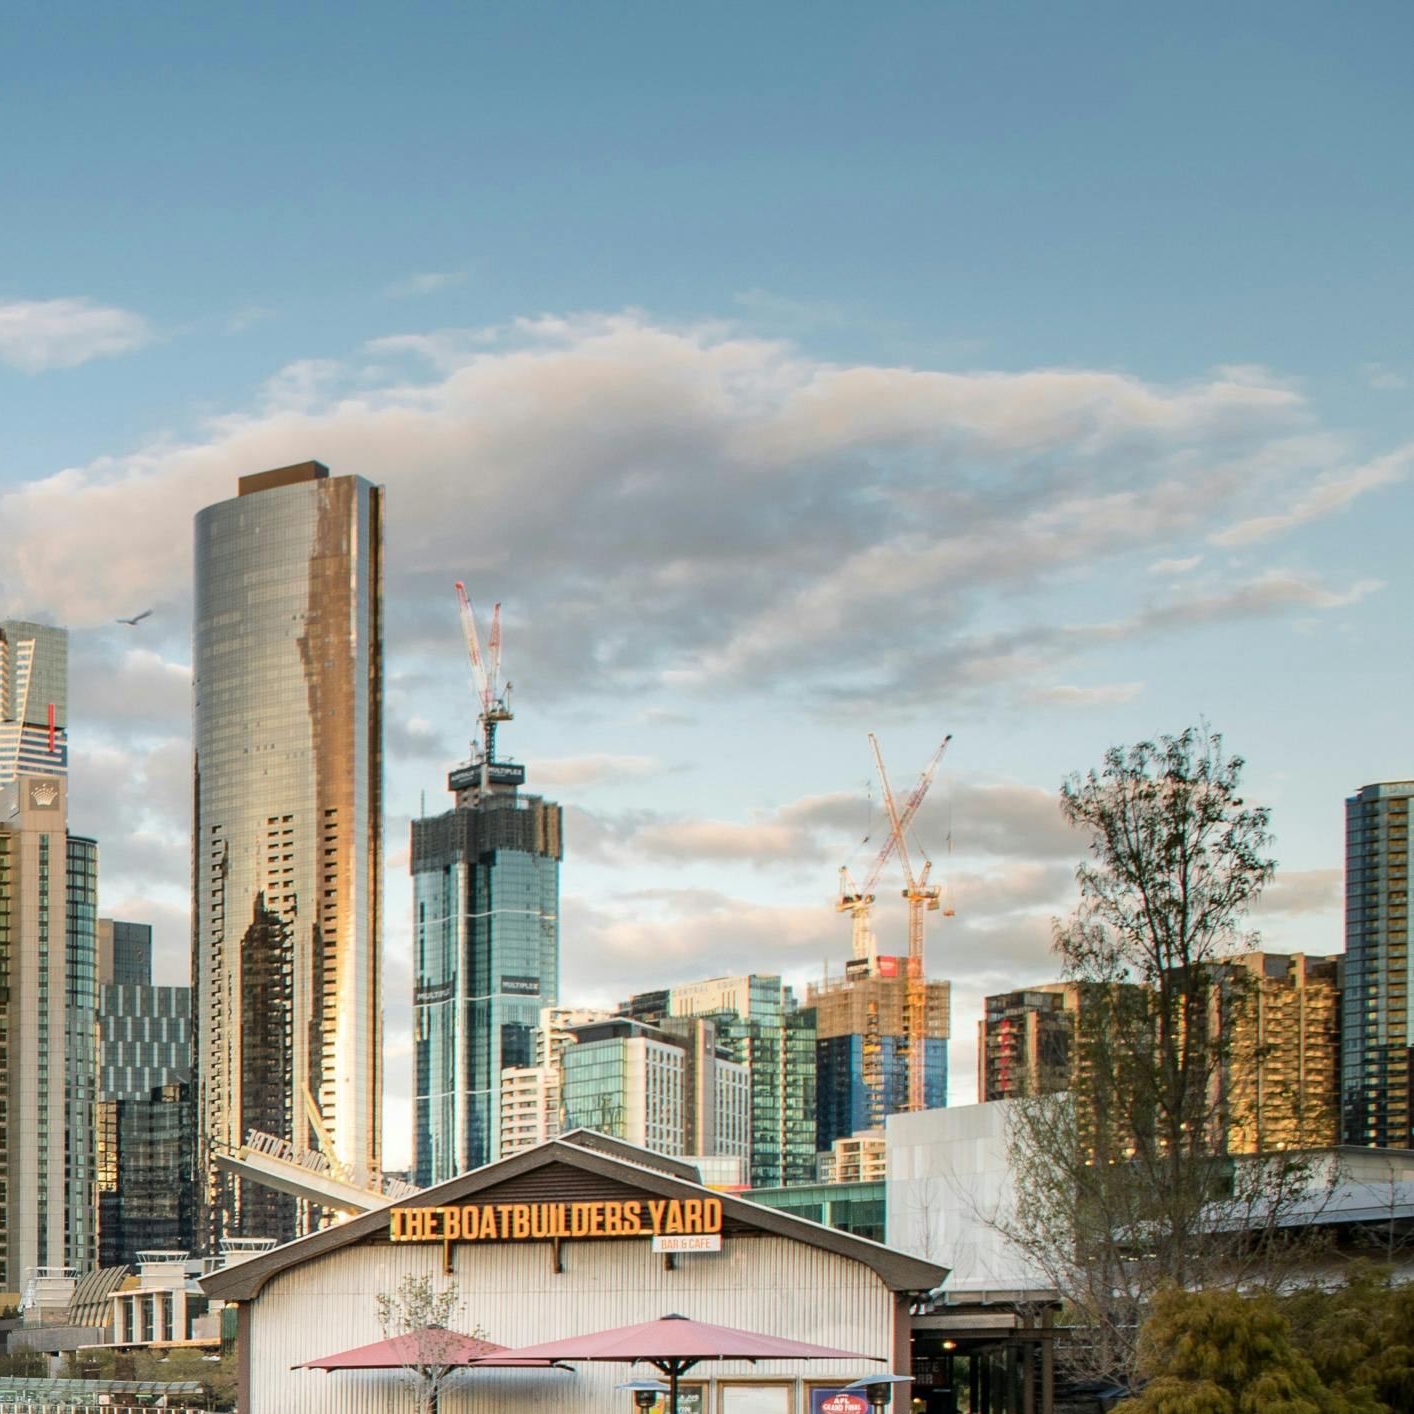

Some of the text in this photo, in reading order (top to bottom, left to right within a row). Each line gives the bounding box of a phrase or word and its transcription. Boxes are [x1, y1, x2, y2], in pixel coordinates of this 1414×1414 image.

[390, 1198, 723, 1241] THE BOATBUILDERS YARD
[661, 1239, 679, 1249] BAR
[689, 1238, 710, 1249] CAFE
[822, 1403, 862, 1412] GRAND FINAL
